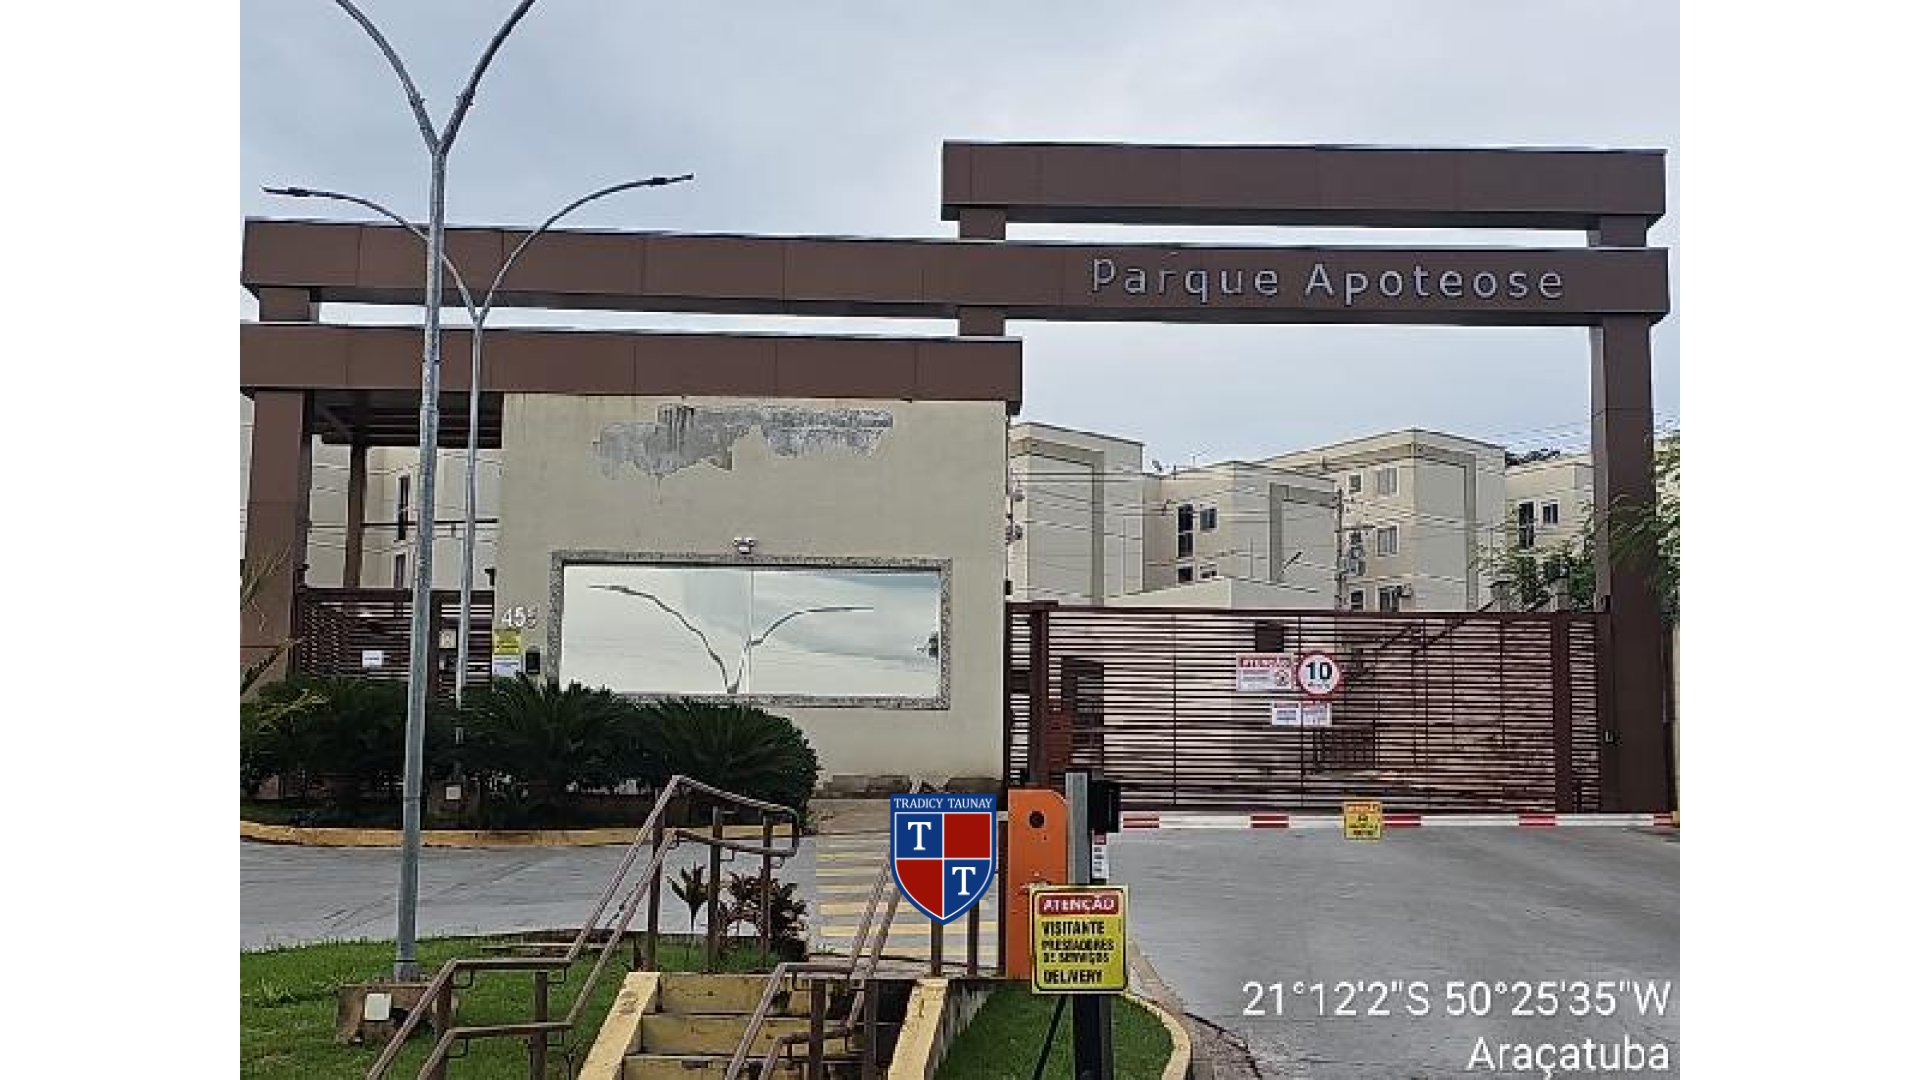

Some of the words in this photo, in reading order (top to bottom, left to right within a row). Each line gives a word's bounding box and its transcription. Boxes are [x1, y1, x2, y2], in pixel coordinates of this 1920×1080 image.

[1092, 257, 1279, 304] Parque
[1306, 262, 1564, 305] Apoteose
[1305, 661, 1333, 680] 10
[1043, 895, 1115, 913] ATENÇÃO
[1042, 920, 1105, 935] VISITANTE
[1043, 968, 1103, 984] DELIVERY
